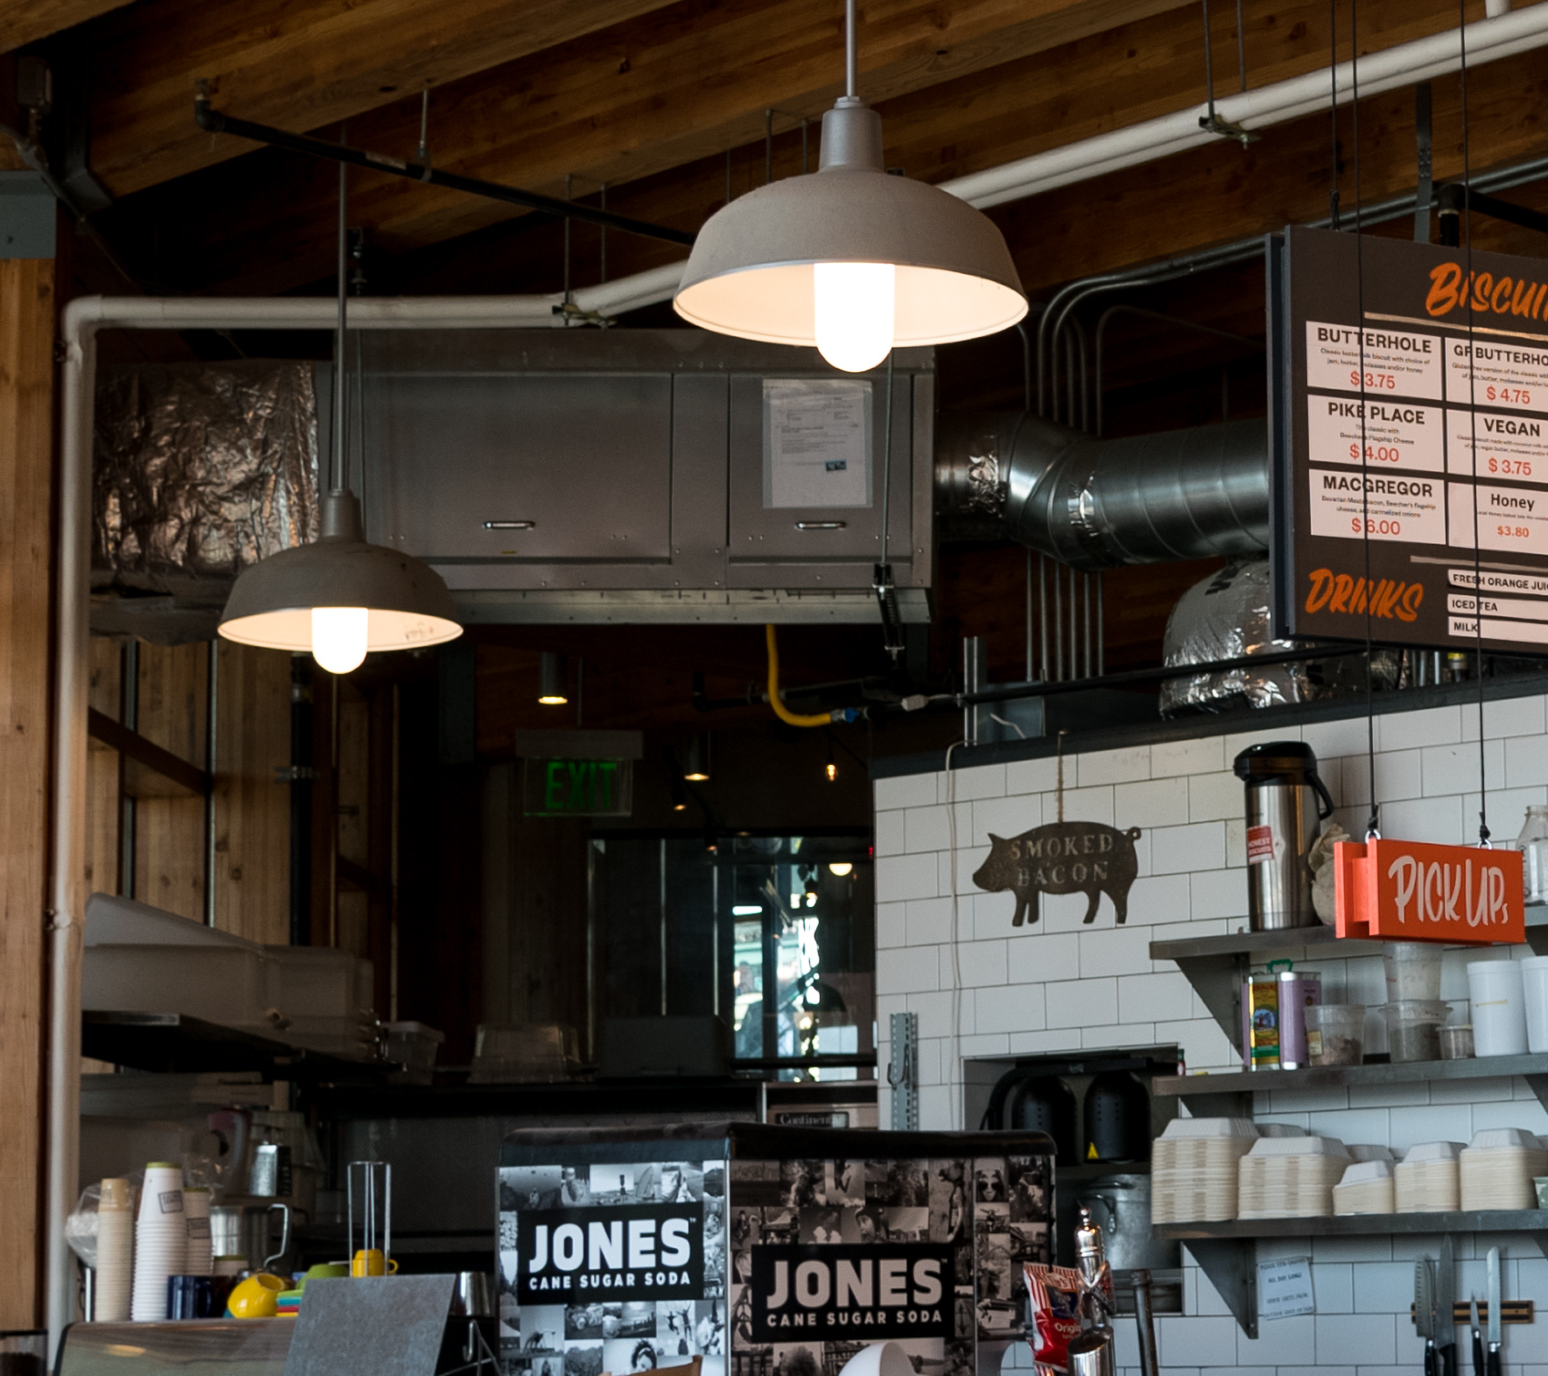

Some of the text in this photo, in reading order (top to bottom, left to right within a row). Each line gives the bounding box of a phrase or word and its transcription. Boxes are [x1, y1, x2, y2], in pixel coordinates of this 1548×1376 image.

[1317, 327, 1432, 353] BUTTERHOLE
[1328, 402, 1425, 424] PIKE PLACE
[1484, 418, 1540, 437] VEGAN
[1323, 475, 1433, 498] MACGREGOR
[1491, 493, 1535, 512] Honey
[1497, 526, 1530, 538] $3.80
[1453, 574, 1485, 586] FRESH
[1488, 577, 1529, 589] ORANGE
[1305, 568, 1424, 623] DRINKS
[1452, 599, 1498, 611] ICED TEA
[1454, 622, 1478, 632] MILK
[546, 762, 617, 809] EXIT
[1010, 833, 1113, 860] SMOKED
[1018, 861, 1108, 886] BACON
[1388, 855, 1462, 924] PICK
[529, 1218, 691, 1273] JONES
[529, 1271, 691, 1290] CANE SUGAR SODA
[767, 1258, 943, 1309] JONES
[767, 1310, 942, 1327] CANE SUGAR SODA
